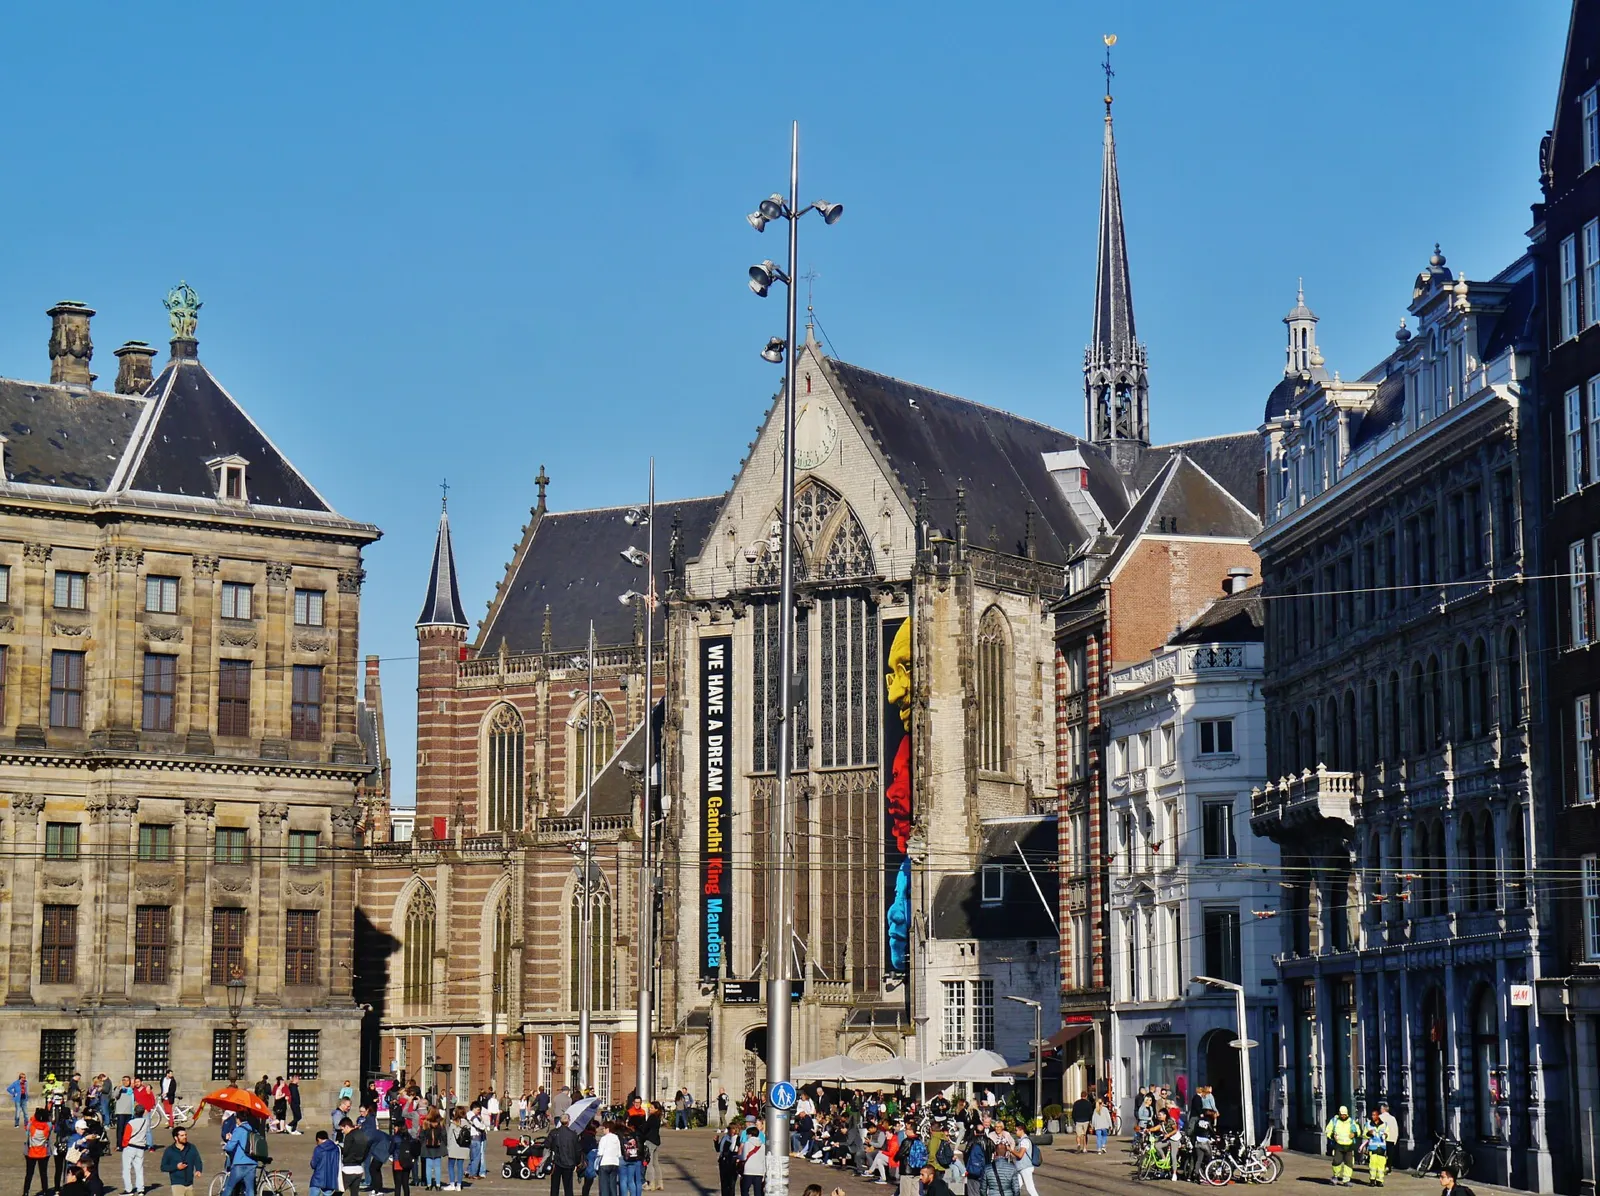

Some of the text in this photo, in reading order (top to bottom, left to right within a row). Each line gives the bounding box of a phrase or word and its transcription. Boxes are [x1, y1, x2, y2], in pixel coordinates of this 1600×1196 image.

[831, 429, 836, 438] 3
[824, 446, 829, 454] 2
[804, 458, 812, 467] 12
[705, 644, 724, 968] WE HAVE A DREAM Gandhi King Mandela
[1513, 990, 1528, 1000] H&M
